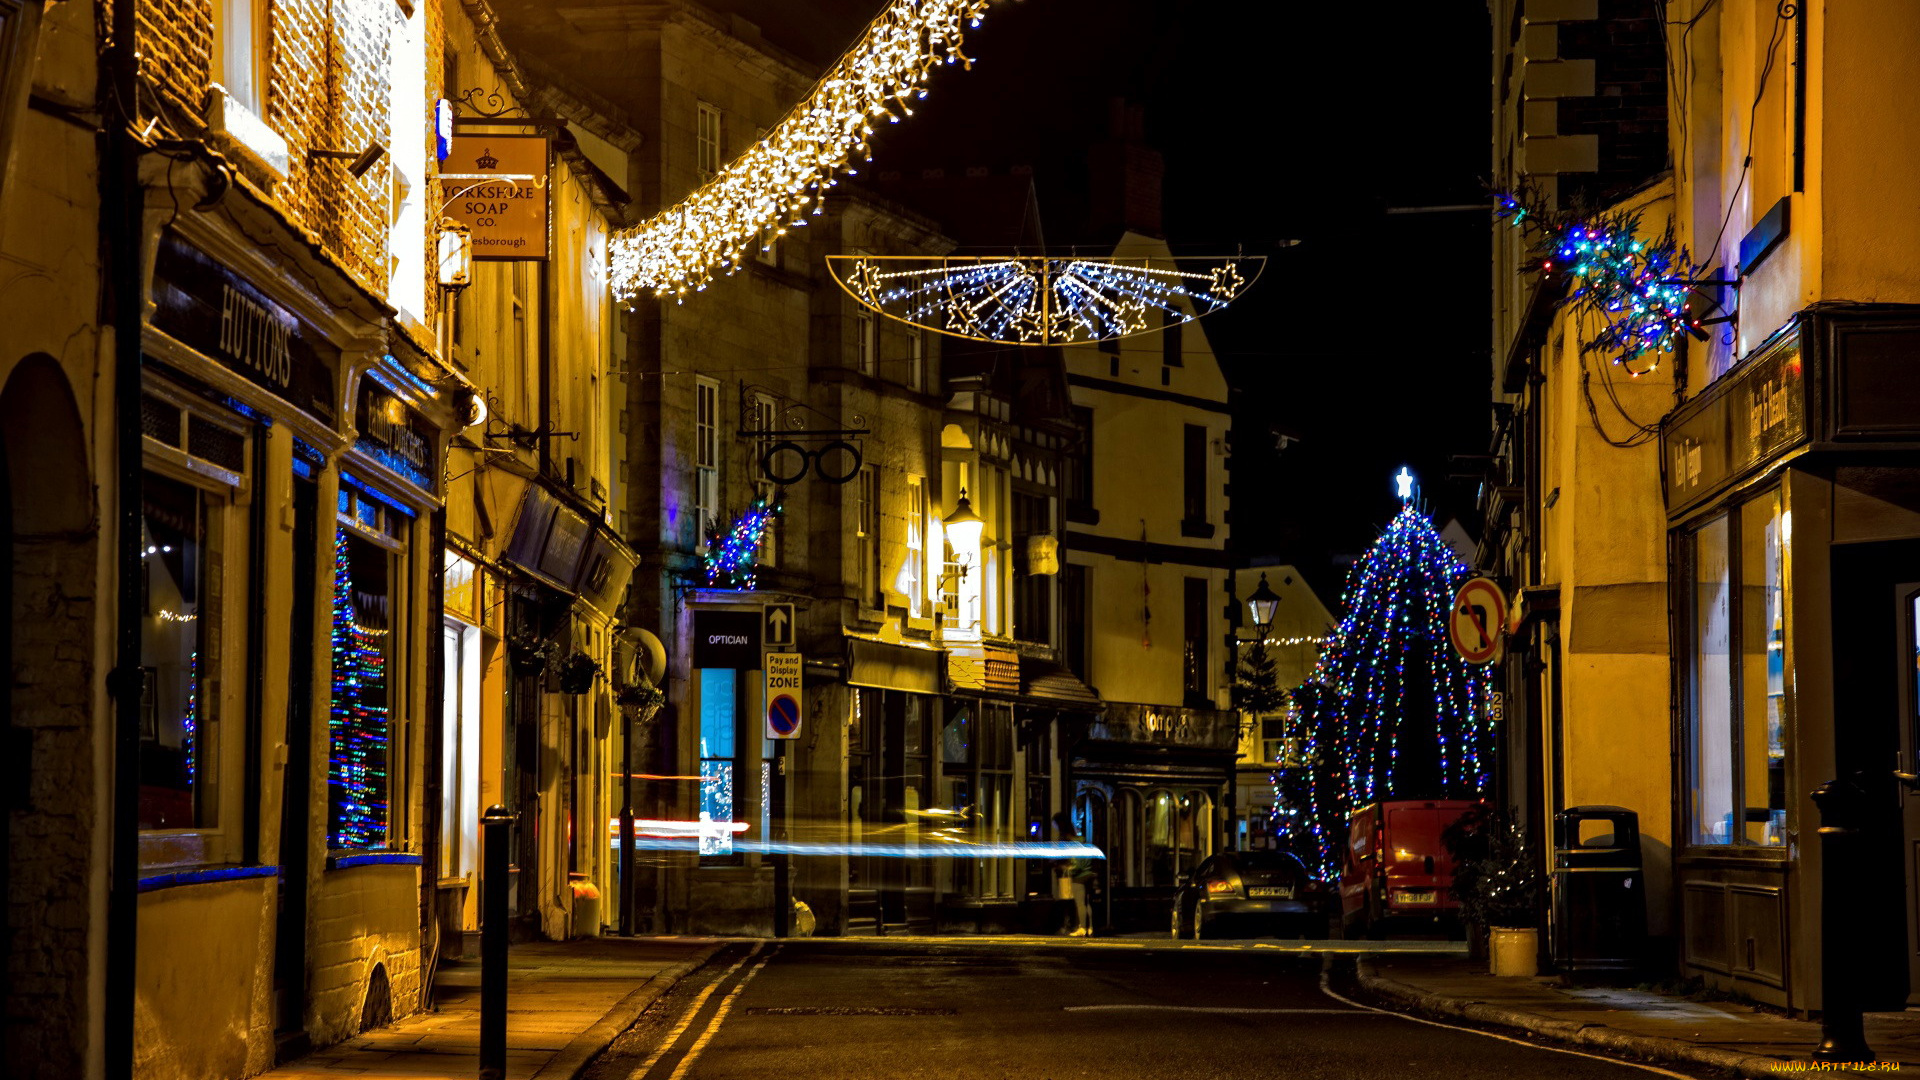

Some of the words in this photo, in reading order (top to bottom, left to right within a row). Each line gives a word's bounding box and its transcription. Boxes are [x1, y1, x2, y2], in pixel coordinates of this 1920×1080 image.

[442, 186, 534, 199] YORKSHIRE
[465, 202, 508, 215] SOAP
[476, 217, 497, 227] CO.
[472, 236, 526, 248] esborough
[219, 283, 292, 388] HUTTONS
[708, 634, 748, 645] OPTICIAN
[769, 656, 783, 665] Pay
[785, 656, 798, 665] and
[770, 666, 798, 676] Display
[769, 677, 799, 688] ZONE
